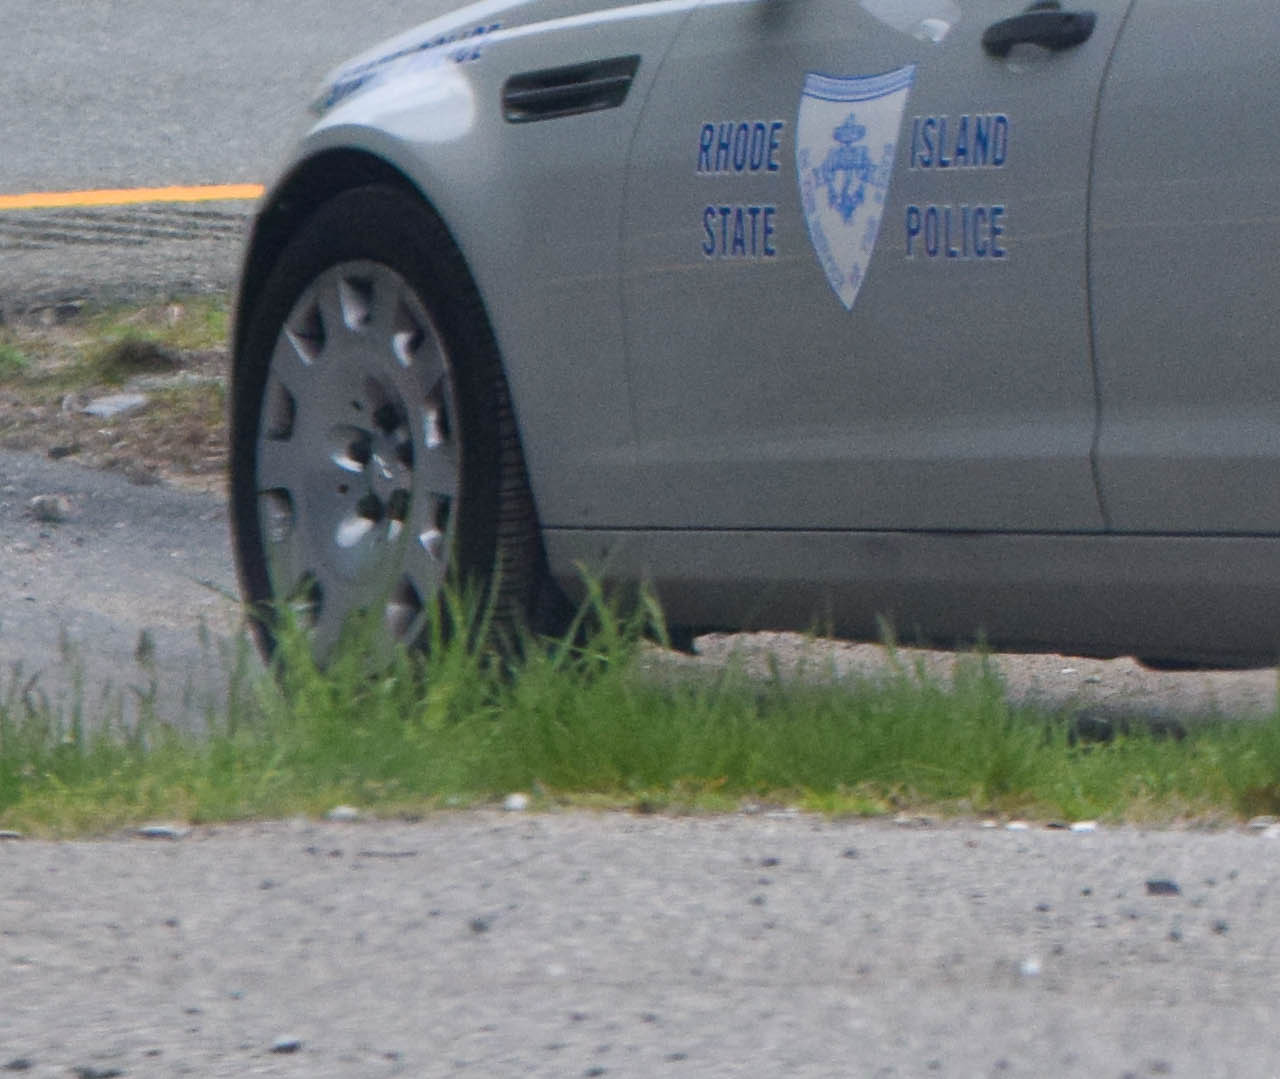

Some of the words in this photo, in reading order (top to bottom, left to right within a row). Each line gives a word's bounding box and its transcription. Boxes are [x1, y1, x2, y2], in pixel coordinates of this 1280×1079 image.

[697, 121, 784, 175] RHODE
[910, 113, 1009, 170] ISLAND
[702, 205, 778, 260] STATE
[905, 204, 1008, 261] POLICE
